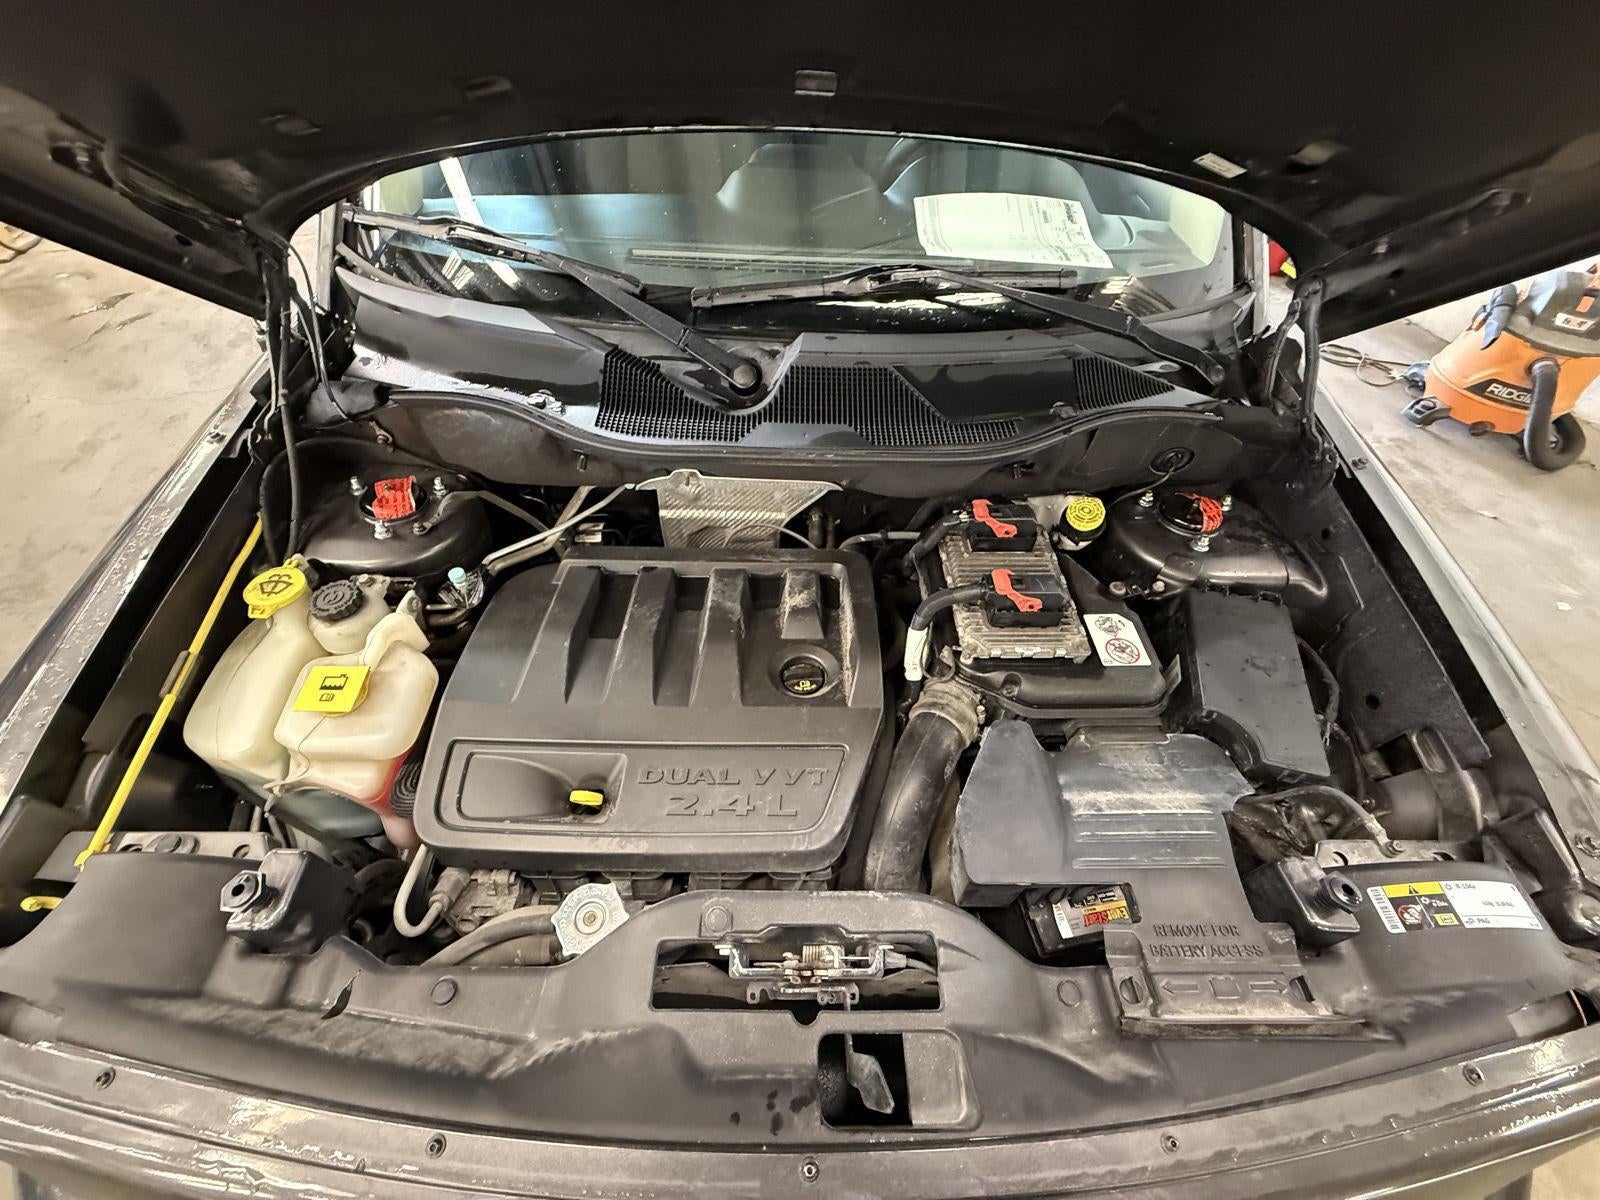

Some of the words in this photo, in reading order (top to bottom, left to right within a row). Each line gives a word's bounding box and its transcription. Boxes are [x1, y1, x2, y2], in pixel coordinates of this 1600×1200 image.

[1486, 383, 1531, 403] RIDGI
[637, 767, 740, 786] DUAL
[664, 794, 798, 817] 2.4L
[1153, 924, 1209, 937] REMOVE
[1211, 924, 1241, 937] FOR
[1149, 944, 1206, 958] BATTERY
[1210, 944, 1264, 958] ACCESS
